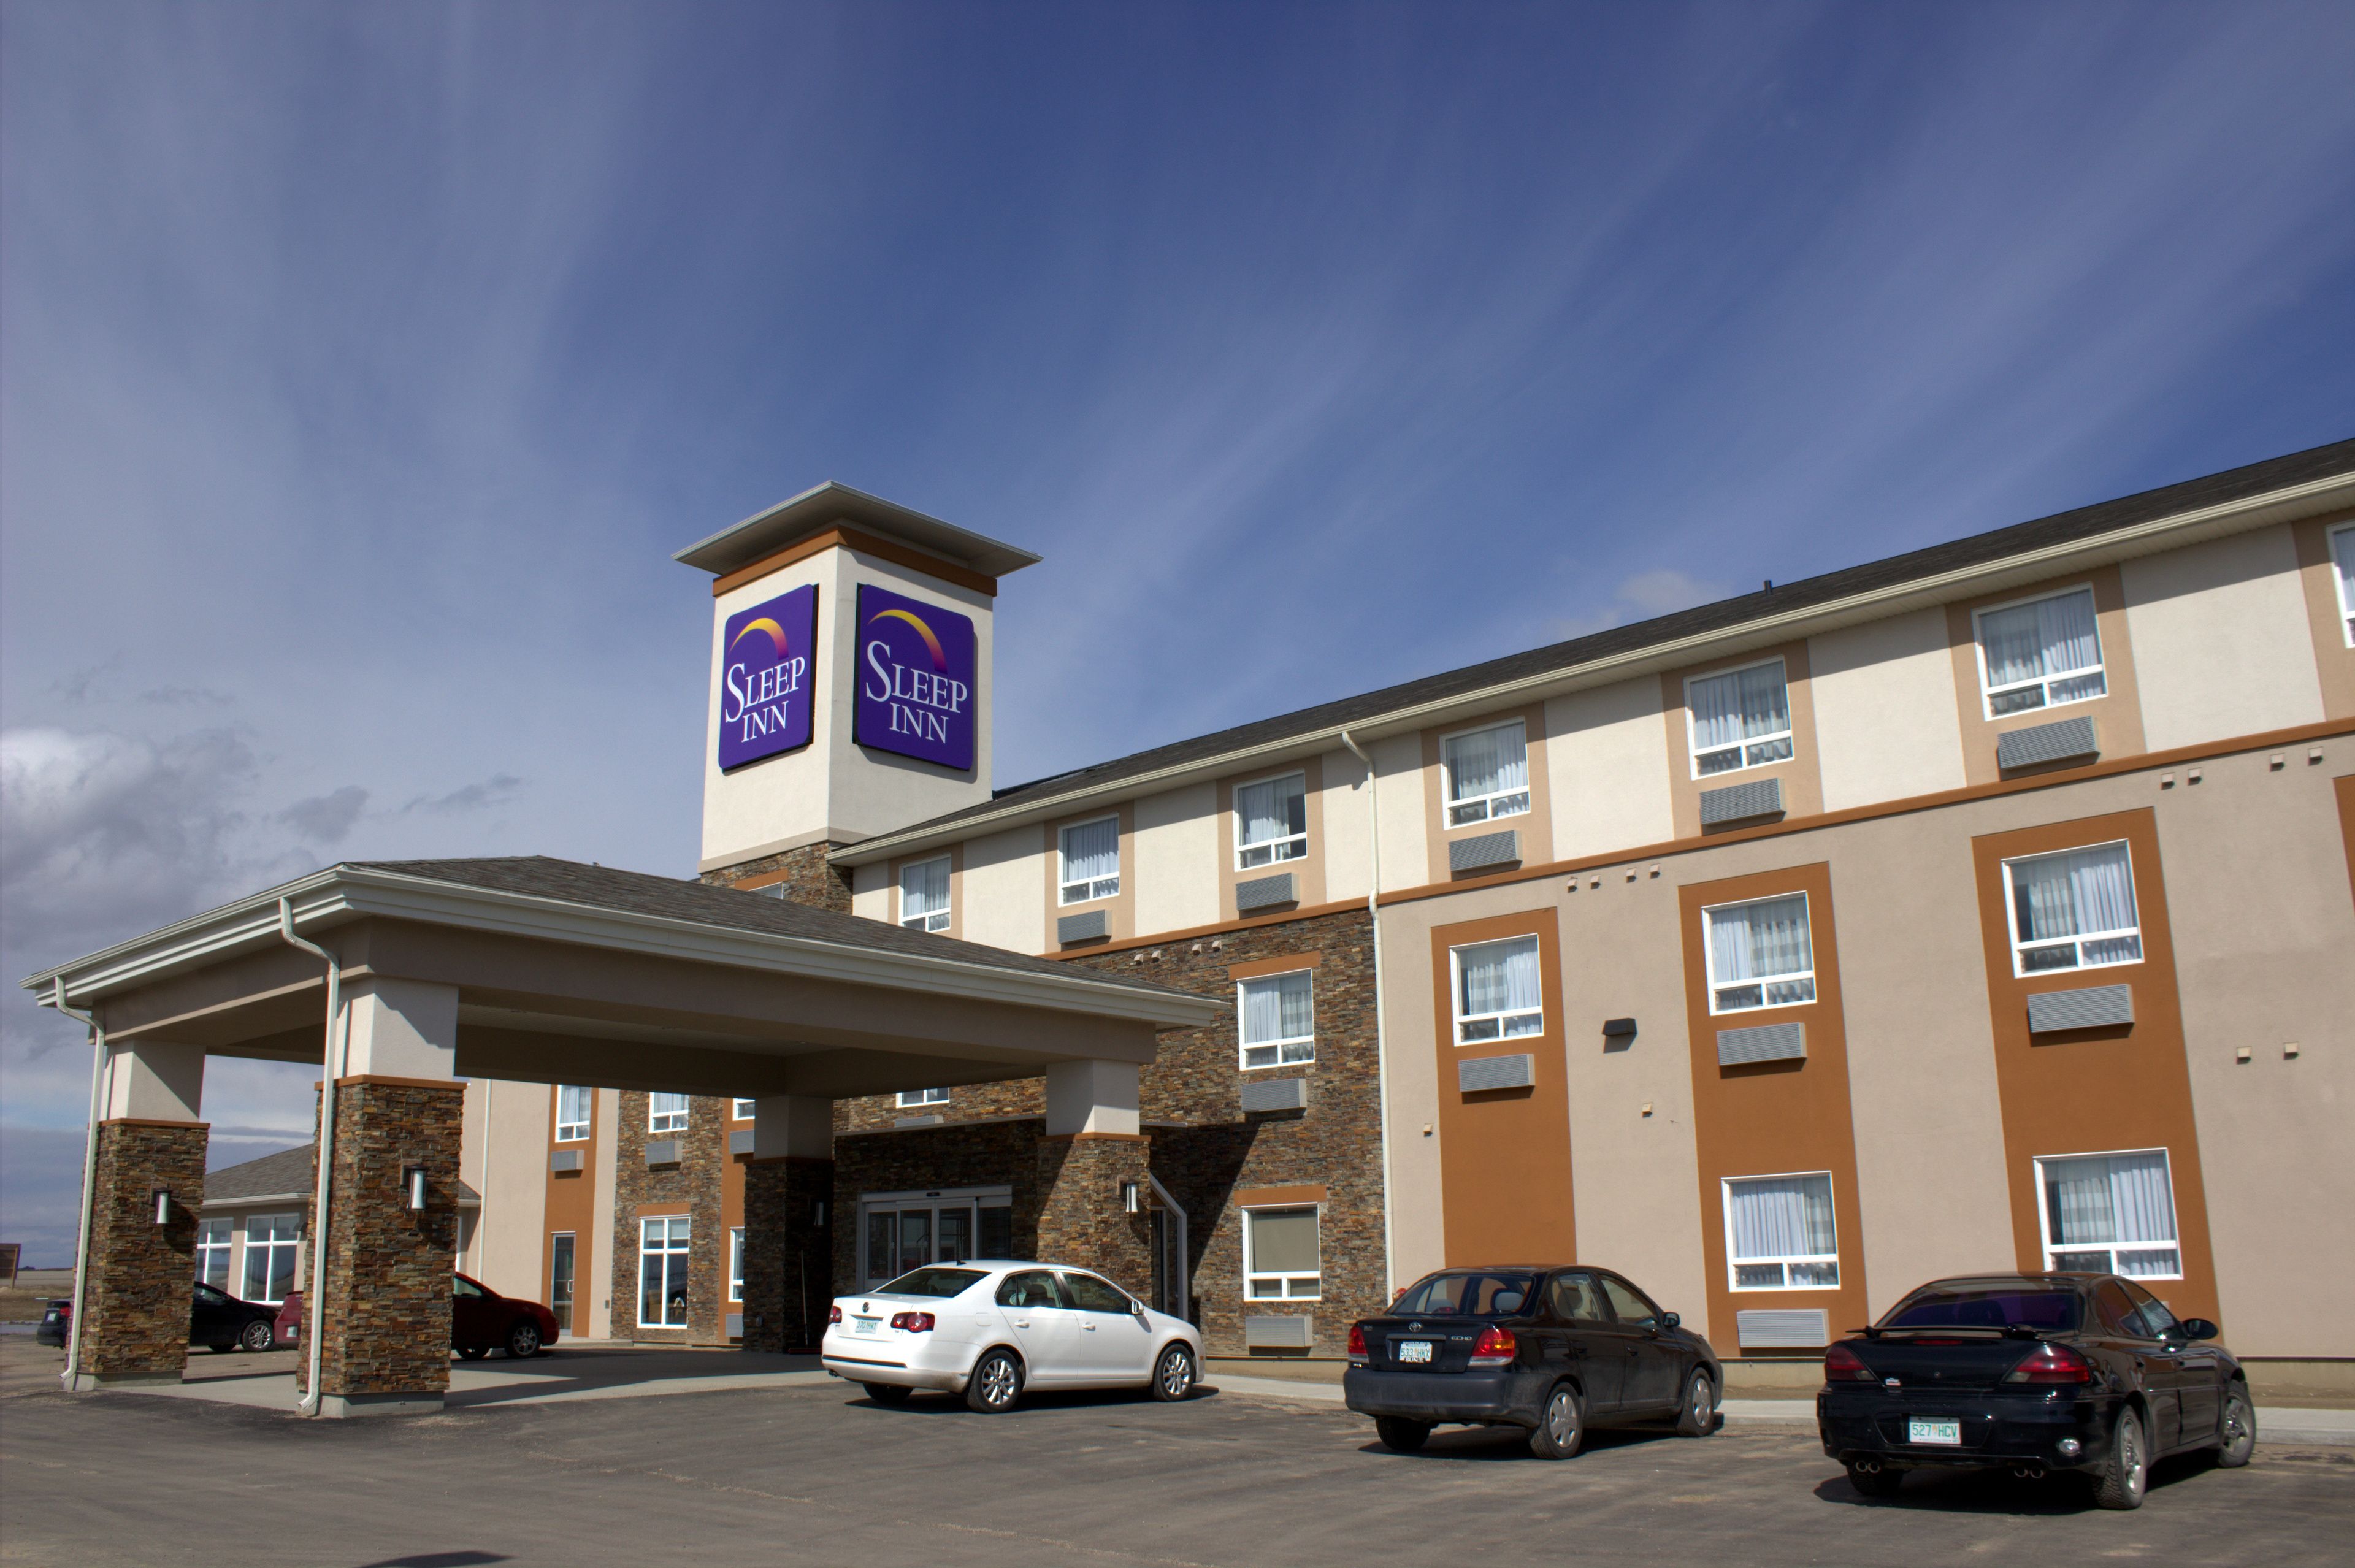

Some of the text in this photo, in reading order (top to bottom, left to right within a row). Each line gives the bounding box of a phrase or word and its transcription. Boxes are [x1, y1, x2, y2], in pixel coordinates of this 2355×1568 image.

[726, 657, 805, 723] SLEEP
[866, 641, 968, 713] SLEEP
[741, 701, 789, 743] INN
[889, 702, 949, 744] INN
[1913, 1424, 1957, 1437] 527 HCV
